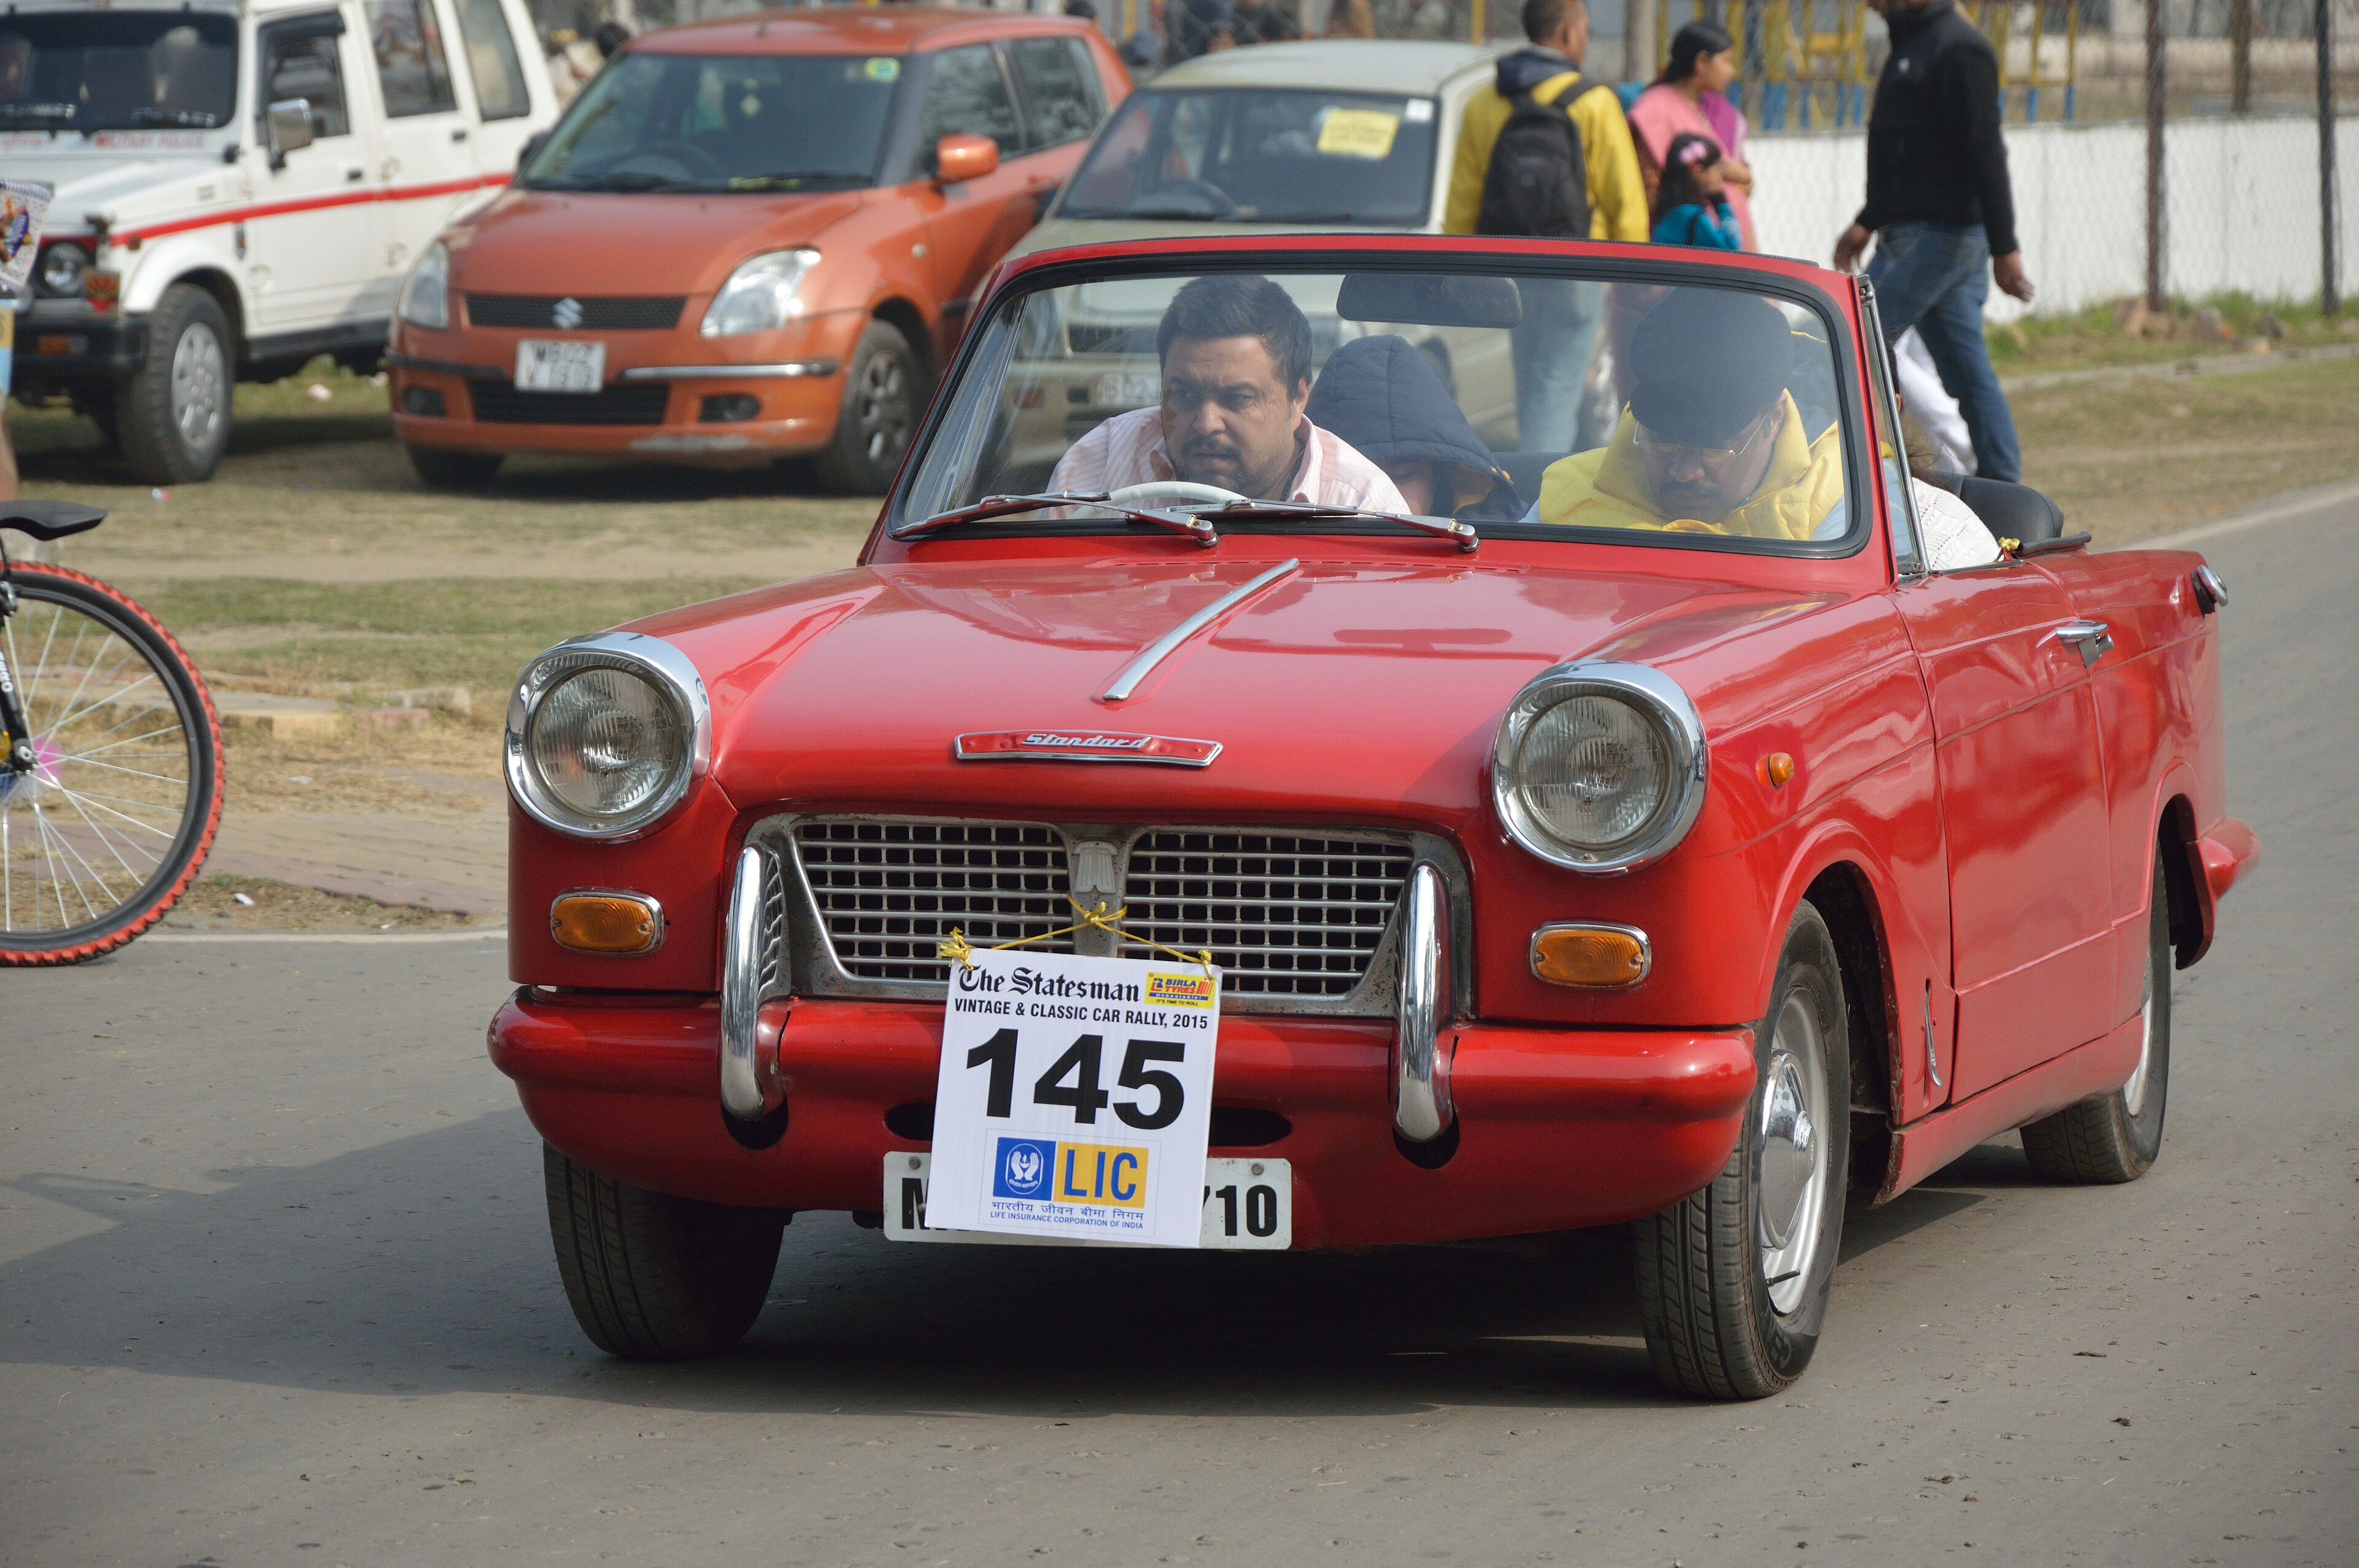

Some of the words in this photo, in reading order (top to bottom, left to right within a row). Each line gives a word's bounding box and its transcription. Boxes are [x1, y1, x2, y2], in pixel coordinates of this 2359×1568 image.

[1022, 733, 1151, 749] Standard
[958, 964, 1005, 993] The
[1007, 966, 1140, 1002] Statesman
[1165, 985, 1196, 994] TYRES
[1166, 978, 1197, 987] BIRLA
[955, 998, 1011, 1015] VINTAGE
[1015, 1002, 1025, 1016] &
[1030, 1003, 1088, 1020] CLASSIC
[1093, 1008, 1121, 1023] CAR
[1125, 1010, 1168, 1028] RALLY,
[1172, 1013, 1208, 1029] 2015
[966, 1028, 1186, 1130] 145
[1063, 1149, 1138, 1201] LIC
[992, 1201, 1034, 1212] भारतीय
[1041, 1203, 1074, 1215] जीवन
[1081, 1206, 1106, 1217] बीमा
[1113, 1208, 1144, 1220] निगम
[1008, 1213, 1052, 1222] INSURANCE
[1054, 1216, 1108, 1226] CORPORATION
